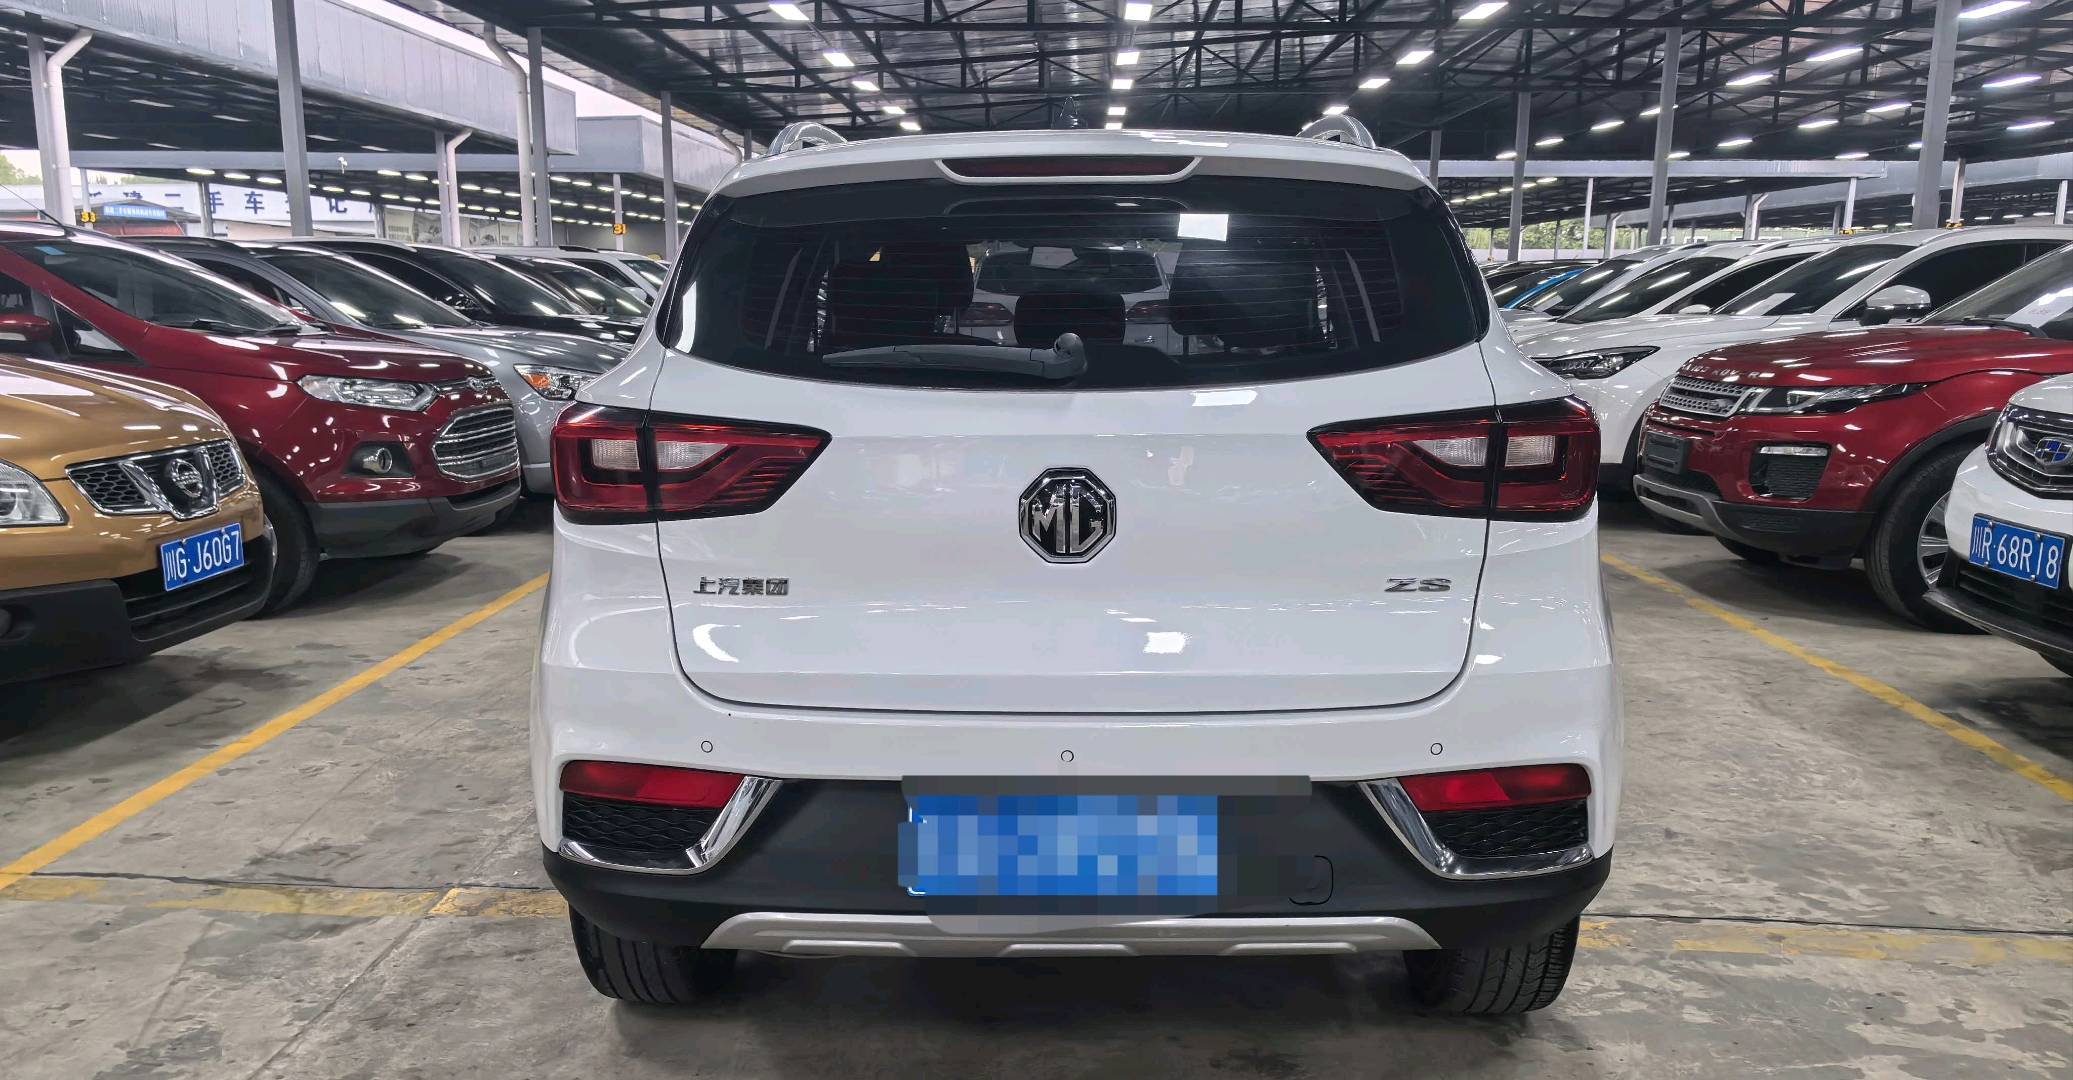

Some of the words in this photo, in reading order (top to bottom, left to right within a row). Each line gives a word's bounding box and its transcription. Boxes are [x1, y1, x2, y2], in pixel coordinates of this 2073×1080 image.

[1031, 483, 1104, 554] MG
[693, 576, 789, 595] 上汽集团
[1384, 578, 1452, 592] ZS
